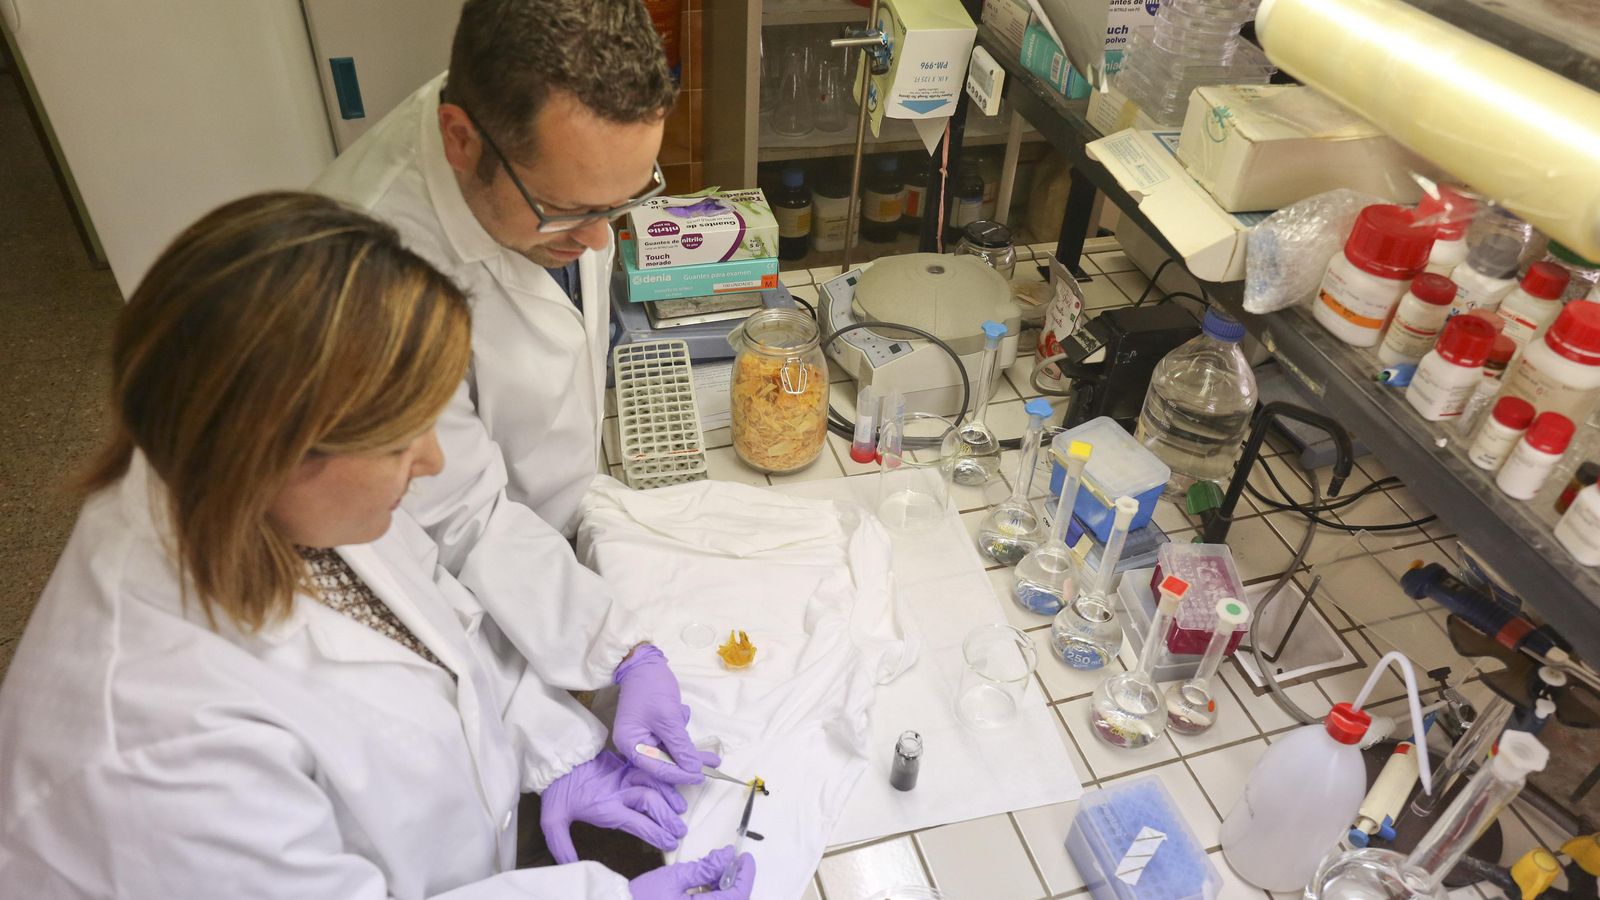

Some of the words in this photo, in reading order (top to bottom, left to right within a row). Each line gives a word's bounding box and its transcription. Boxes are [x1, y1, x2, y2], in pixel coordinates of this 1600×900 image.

[1107, 25, 1129, 35] uch
[1105, 36, 1127, 45] polvo
[920, 61, 949, 70] PM-996
[647, 226, 679, 234] nitrilo
[645, 253, 670, 261] Touch
[643, 274, 672, 283] denia
[683, 273, 710, 281] Guantes
[711, 272, 726, 280] para
[1066, 651, 1091, 665] 250
